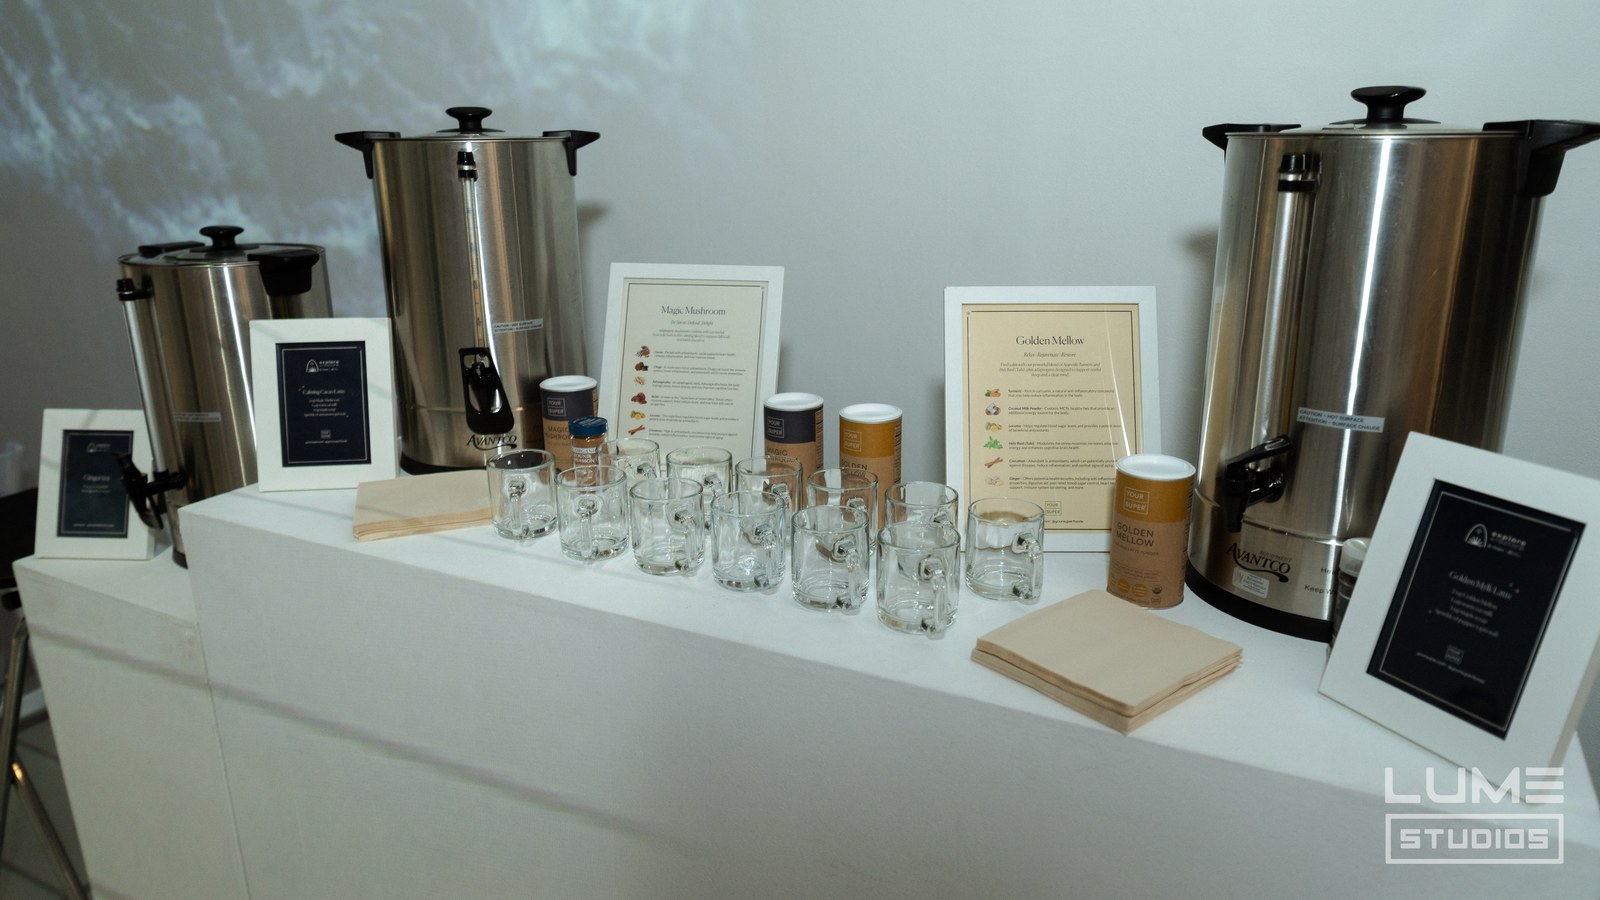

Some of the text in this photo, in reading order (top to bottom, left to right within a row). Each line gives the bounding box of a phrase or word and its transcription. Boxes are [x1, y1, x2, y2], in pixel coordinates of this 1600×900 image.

[661, 306, 726, 316] Magic Mushroom
[1016, 336, 1084, 345] Golden Mellow
[467, 434, 517, 447] AVANTCO
[766, 447, 788, 456] MAGIC
[1126, 490, 1144, 500] YOUR
[1125, 501, 1146, 512] SUPER
[1117, 522, 1154, 538] GOLDEN
[1116, 530, 1154, 548] MELLOW
[1492, 531, 1527, 546] explore
[1226, 542, 1291, 574] AVANTCO
[1304, 584, 1323, 594] Keep
